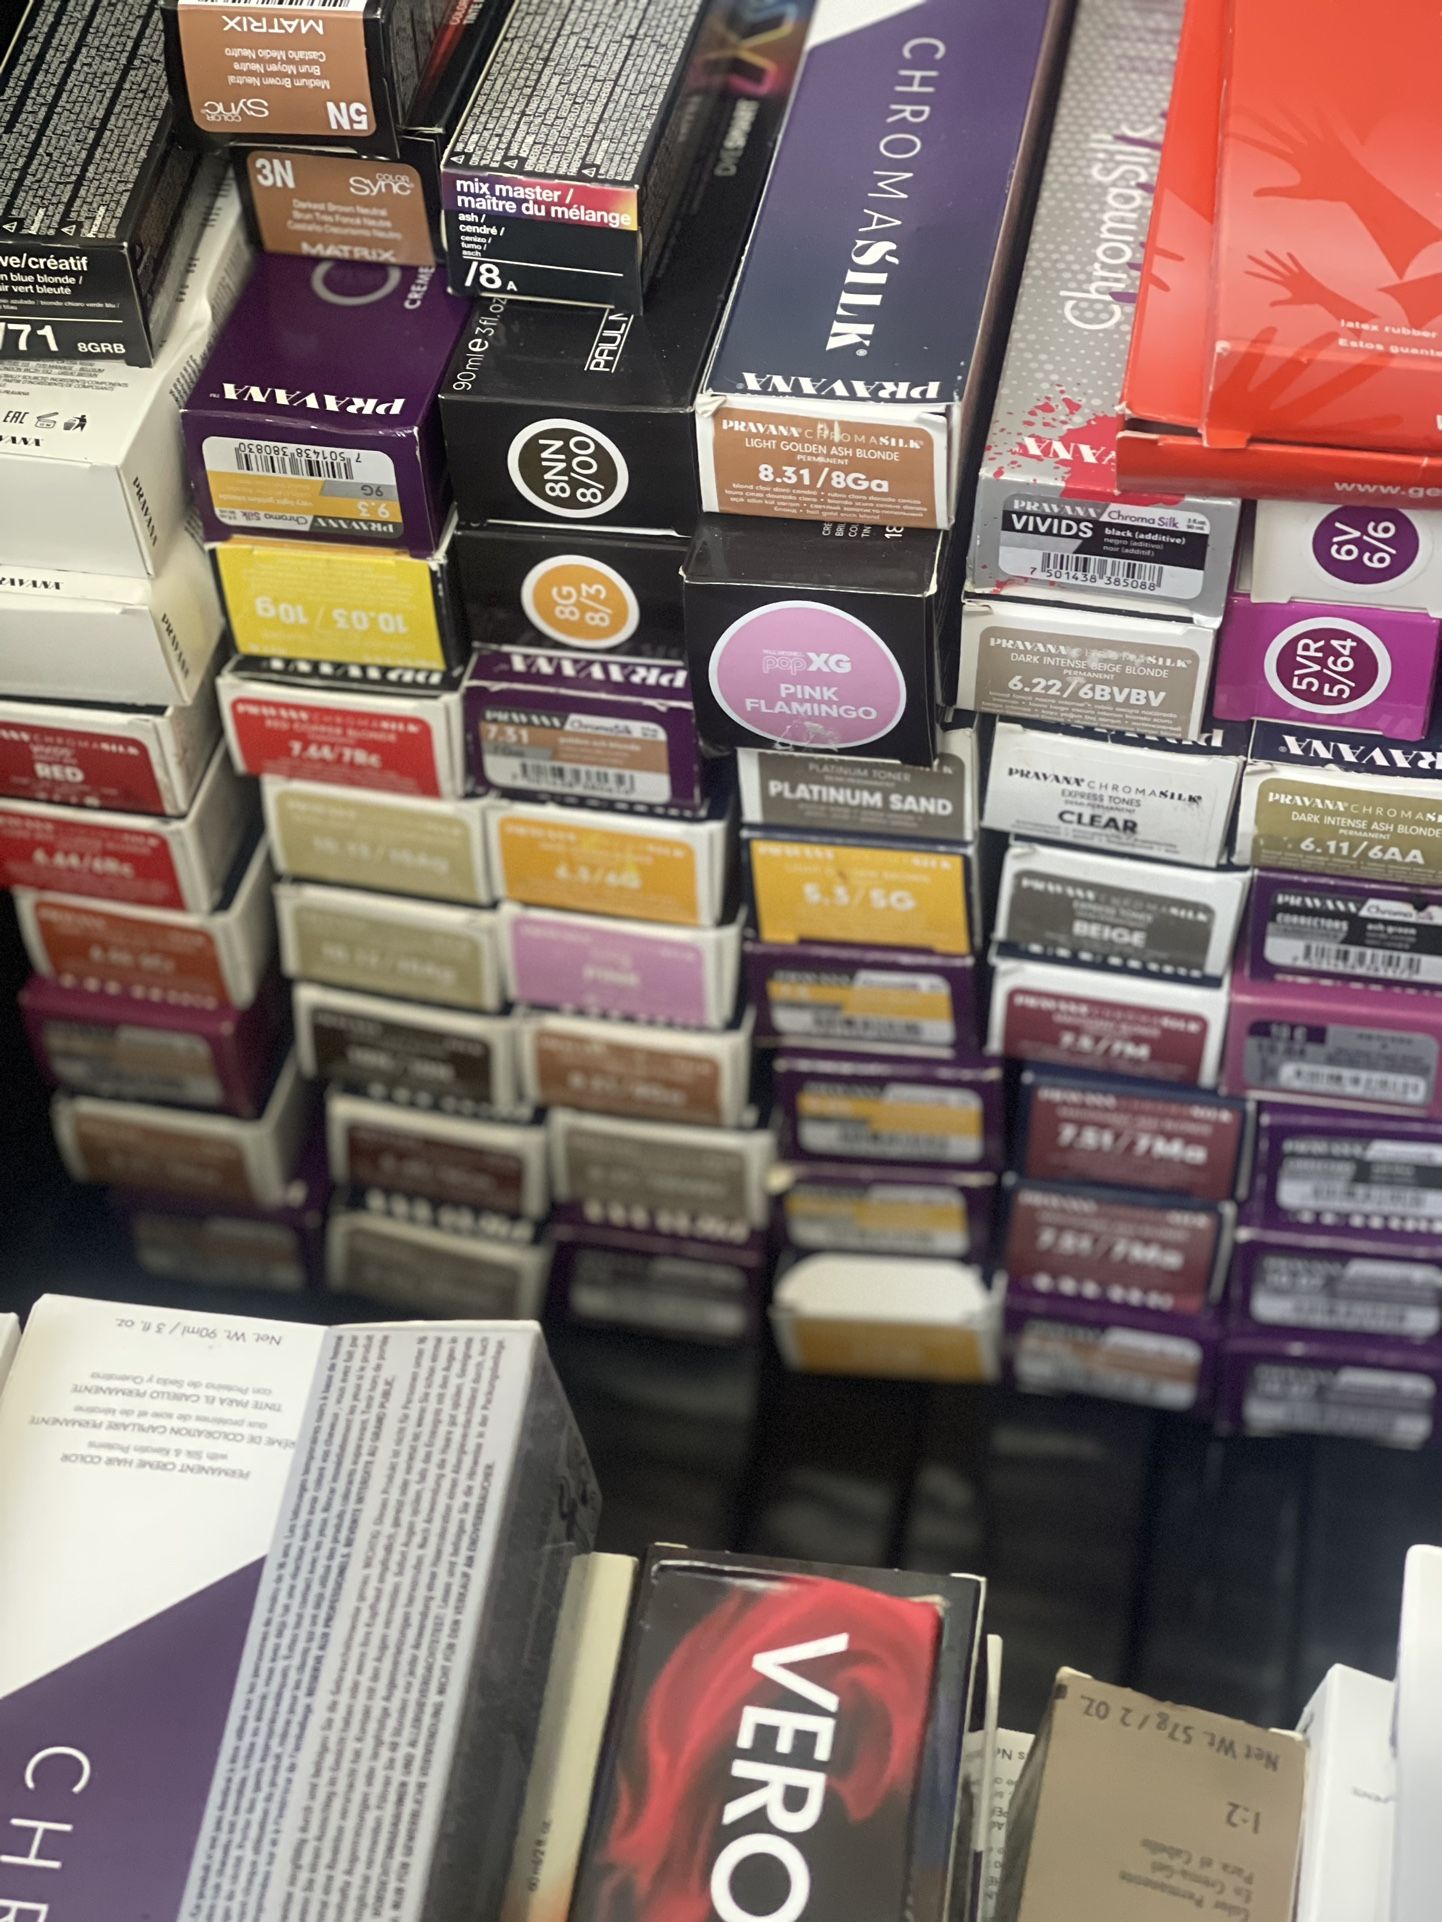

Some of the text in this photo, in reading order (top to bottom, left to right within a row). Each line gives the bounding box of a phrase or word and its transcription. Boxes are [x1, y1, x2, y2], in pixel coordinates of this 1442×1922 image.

[222, 15, 324, 35] MATRIX
[225, 48, 326, 62] Castaño Medio Neutro
[233, 62, 320, 75] Brun Moyen Neutre
[228, 75, 330, 90] Medium Brown Neutral
[326, 102, 368, 130] 5N
[255, 158, 295, 189] 3N
[456, 178, 562, 203] mix master
[825, 36, 947, 351] CHROMASILK
[457, 194, 632, 228] maître du mélange
[458, 212, 478, 222] ash
[459, 224, 498, 236] cendré
[460, 235, 487, 244] cenizo
[300, 241, 397, 262] MATRIX
[461, 242, 482, 250] fumo
[10, 272, 76, 284] blue blonde
[11, 284, 34, 293] vert
[464, 260, 518, 292] /8 A
[1340, 318, 1438, 338] latex rubber
[77, 342, 126, 354] 8GRB
[589, 323, 627, 372] PAUL
[1338, 338, 1384, 352] Estos
[222, 382, 406, 415] PRAVANA
[742, 372, 942, 400] PRAVANA
[2, 410, 30, 424] EAC
[722, 418, 799, 438] PRAVANA
[238, 442, 346, 462] 501438 380830
[745, 438, 901, 462] LIGHT GOLDEN ASH BLONDE
[796, 454, 849, 466] PERMANENT
[538, 439, 571, 498] 8NN
[569, 436, 605, 504] 8/00
[758, 464, 890, 493] 8.31/8Ga
[360, 484, 384, 496] 9G
[357, 501, 391, 518] 9.3
[1013, 499, 1099, 518] PRAVANA
[1108, 510, 1156, 525] Chroma
[1157, 516, 1180, 528] Silk
[314, 518, 394, 533] PRAVANA
[1011, 513, 1094, 538] VIVIDS
[1104, 527, 1186, 545] black (additive)
[1330, 521, 1362, 562] 6V
[1362, 520, 1397, 568] 6/6
[1030, 566, 1156, 592] 7 501438 385088
[552, 585, 580, 622] 8G
[580, 583, 614, 628] 8/3
[990, 637, 1066, 656] PRAVANA
[510, 654, 688, 688] PRAVANA
[1011, 652, 1040, 664] DARK
[1043, 656, 1087, 669] INTENSE
[1125, 666, 1170, 678] BLONDE
[1063, 668, 1114, 680] PERMANENT
[1293, 638, 1325, 692] 5VR
[1323, 638, 1357, 699] 5/64
[780, 683, 840, 702] PINK
[1008, 675, 1166, 707] 6.22/6BVBV
[744, 698, 878, 720] FLAMINGO
[34, 762, 85, 783] RED
[808, 762, 870, 778] PLATINUM
[872, 769, 910, 782] TONER
[768, 780, 882, 808] PLATINUM
[890, 794, 953, 816] SAND
[1008, 767, 1199, 804] PRAVANA CHROMASILK
[1061, 788, 1142, 808] EXPRESS TONES
[1268, 792, 1345, 812] PRAVANA
[1058, 810, 1138, 834] CLEAR
[1292, 812, 1442, 838] DARK INTENSE ASH BLONDE
[1300, 837, 1425, 864] 6.11/6AA
[1072, 919, 1146, 948] BEIGE
[155, 1322, 282, 1347] Net. Wt. 90ml 3
[70, 1384, 282, 1413] TINTE PARA EL CABELLO PERMANENTE
[27, 1414, 262, 1446] DE COLORATION CAPILLAIRE PERMANENTE
[60, 1452, 251, 1480] PERMANENT CREME HAIR COLOR
[1119, 1706, 1134, 1727] 2
[1154, 1712, 1196, 1745] 57g
[1244, 1744, 1280, 1772] Net
[710, 1632, 850, 1922] VERO
[1225, 1801, 1261, 1835] 1:2
